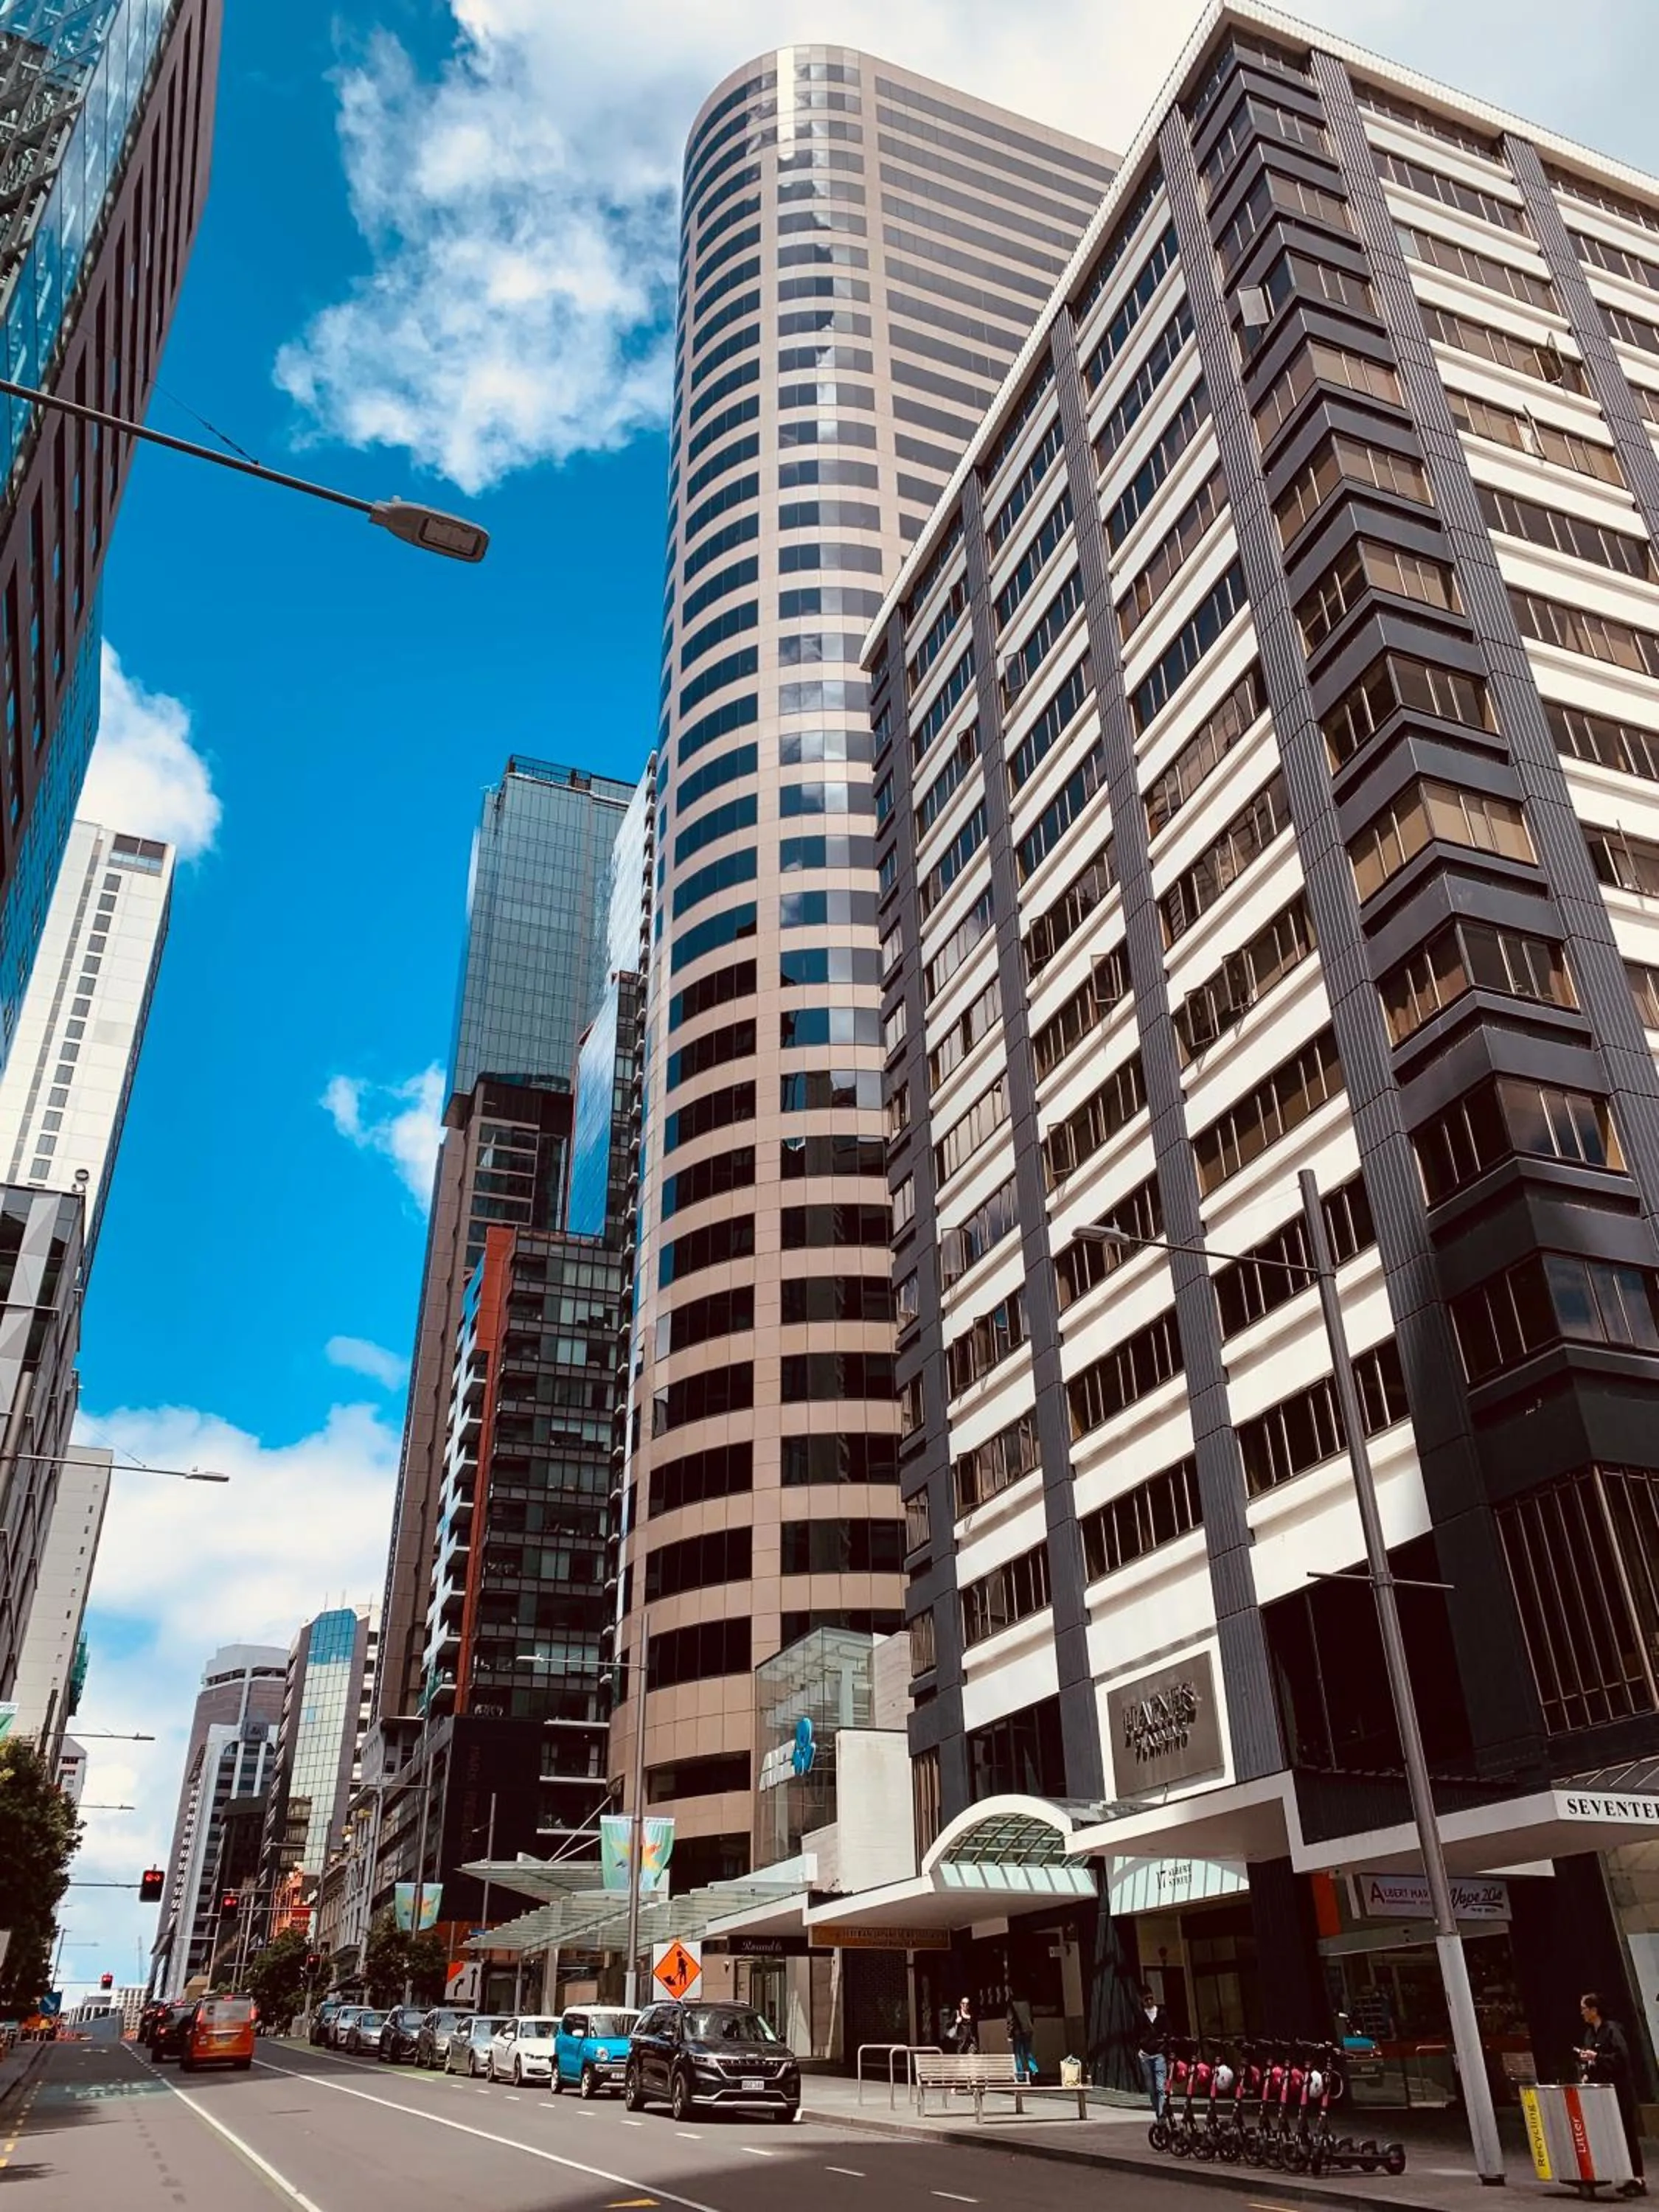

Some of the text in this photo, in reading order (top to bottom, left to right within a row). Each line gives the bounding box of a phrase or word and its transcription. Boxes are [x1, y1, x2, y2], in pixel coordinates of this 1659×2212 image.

[1410, 1888, 1430, 1899] MAR
[1527, 2103, 1545, 2167] Recycling
[1572, 2116, 1587, 2153] Litter
